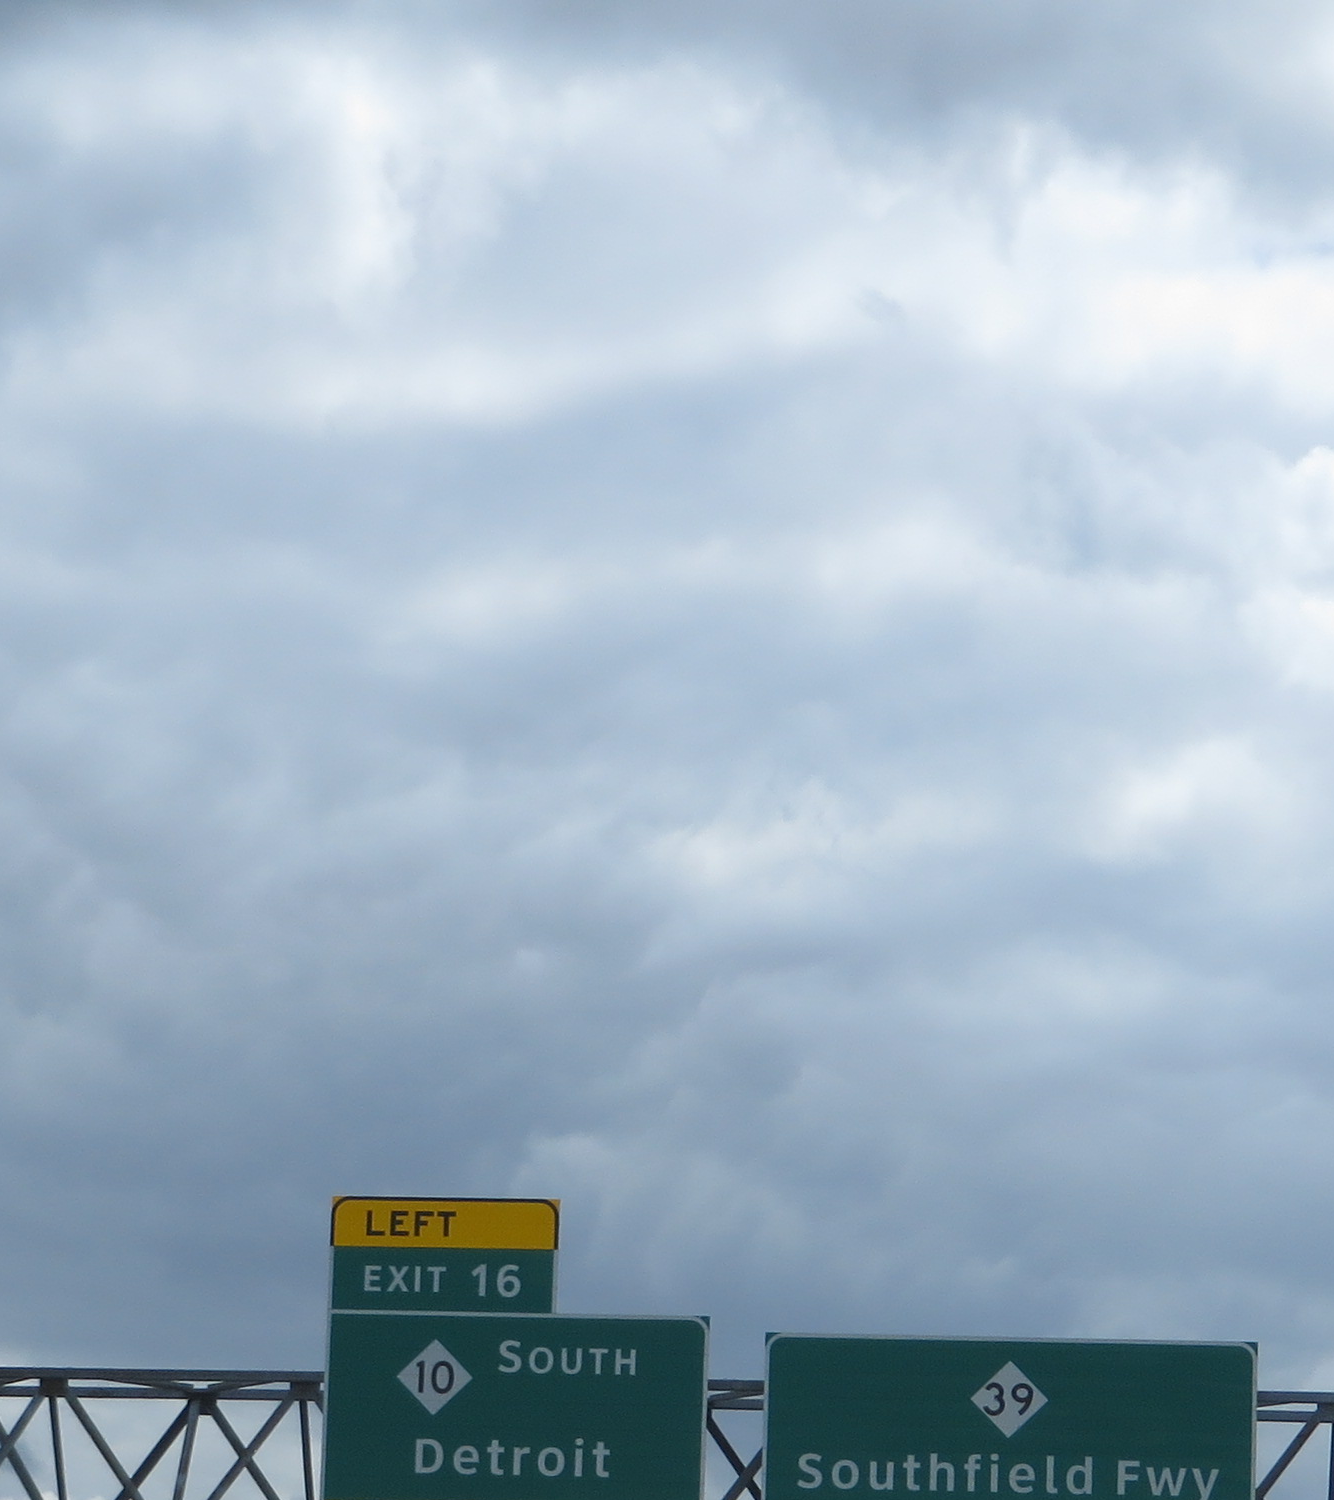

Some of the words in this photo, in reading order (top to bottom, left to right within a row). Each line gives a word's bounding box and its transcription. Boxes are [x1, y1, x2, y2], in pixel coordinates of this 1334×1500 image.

[366, 1210, 456, 1237] LEFT
[364, 1265, 446, 1292] EXIT
[472, 1264, 520, 1297] 16
[415, 1360, 456, 1395] 10
[498, 1340, 636, 1375] SOUTH
[982, 1381, 1035, 1417] 39
[415, 1438, 610, 1477] Detroit
[797, 1453, 1092, 1494] Southfield
